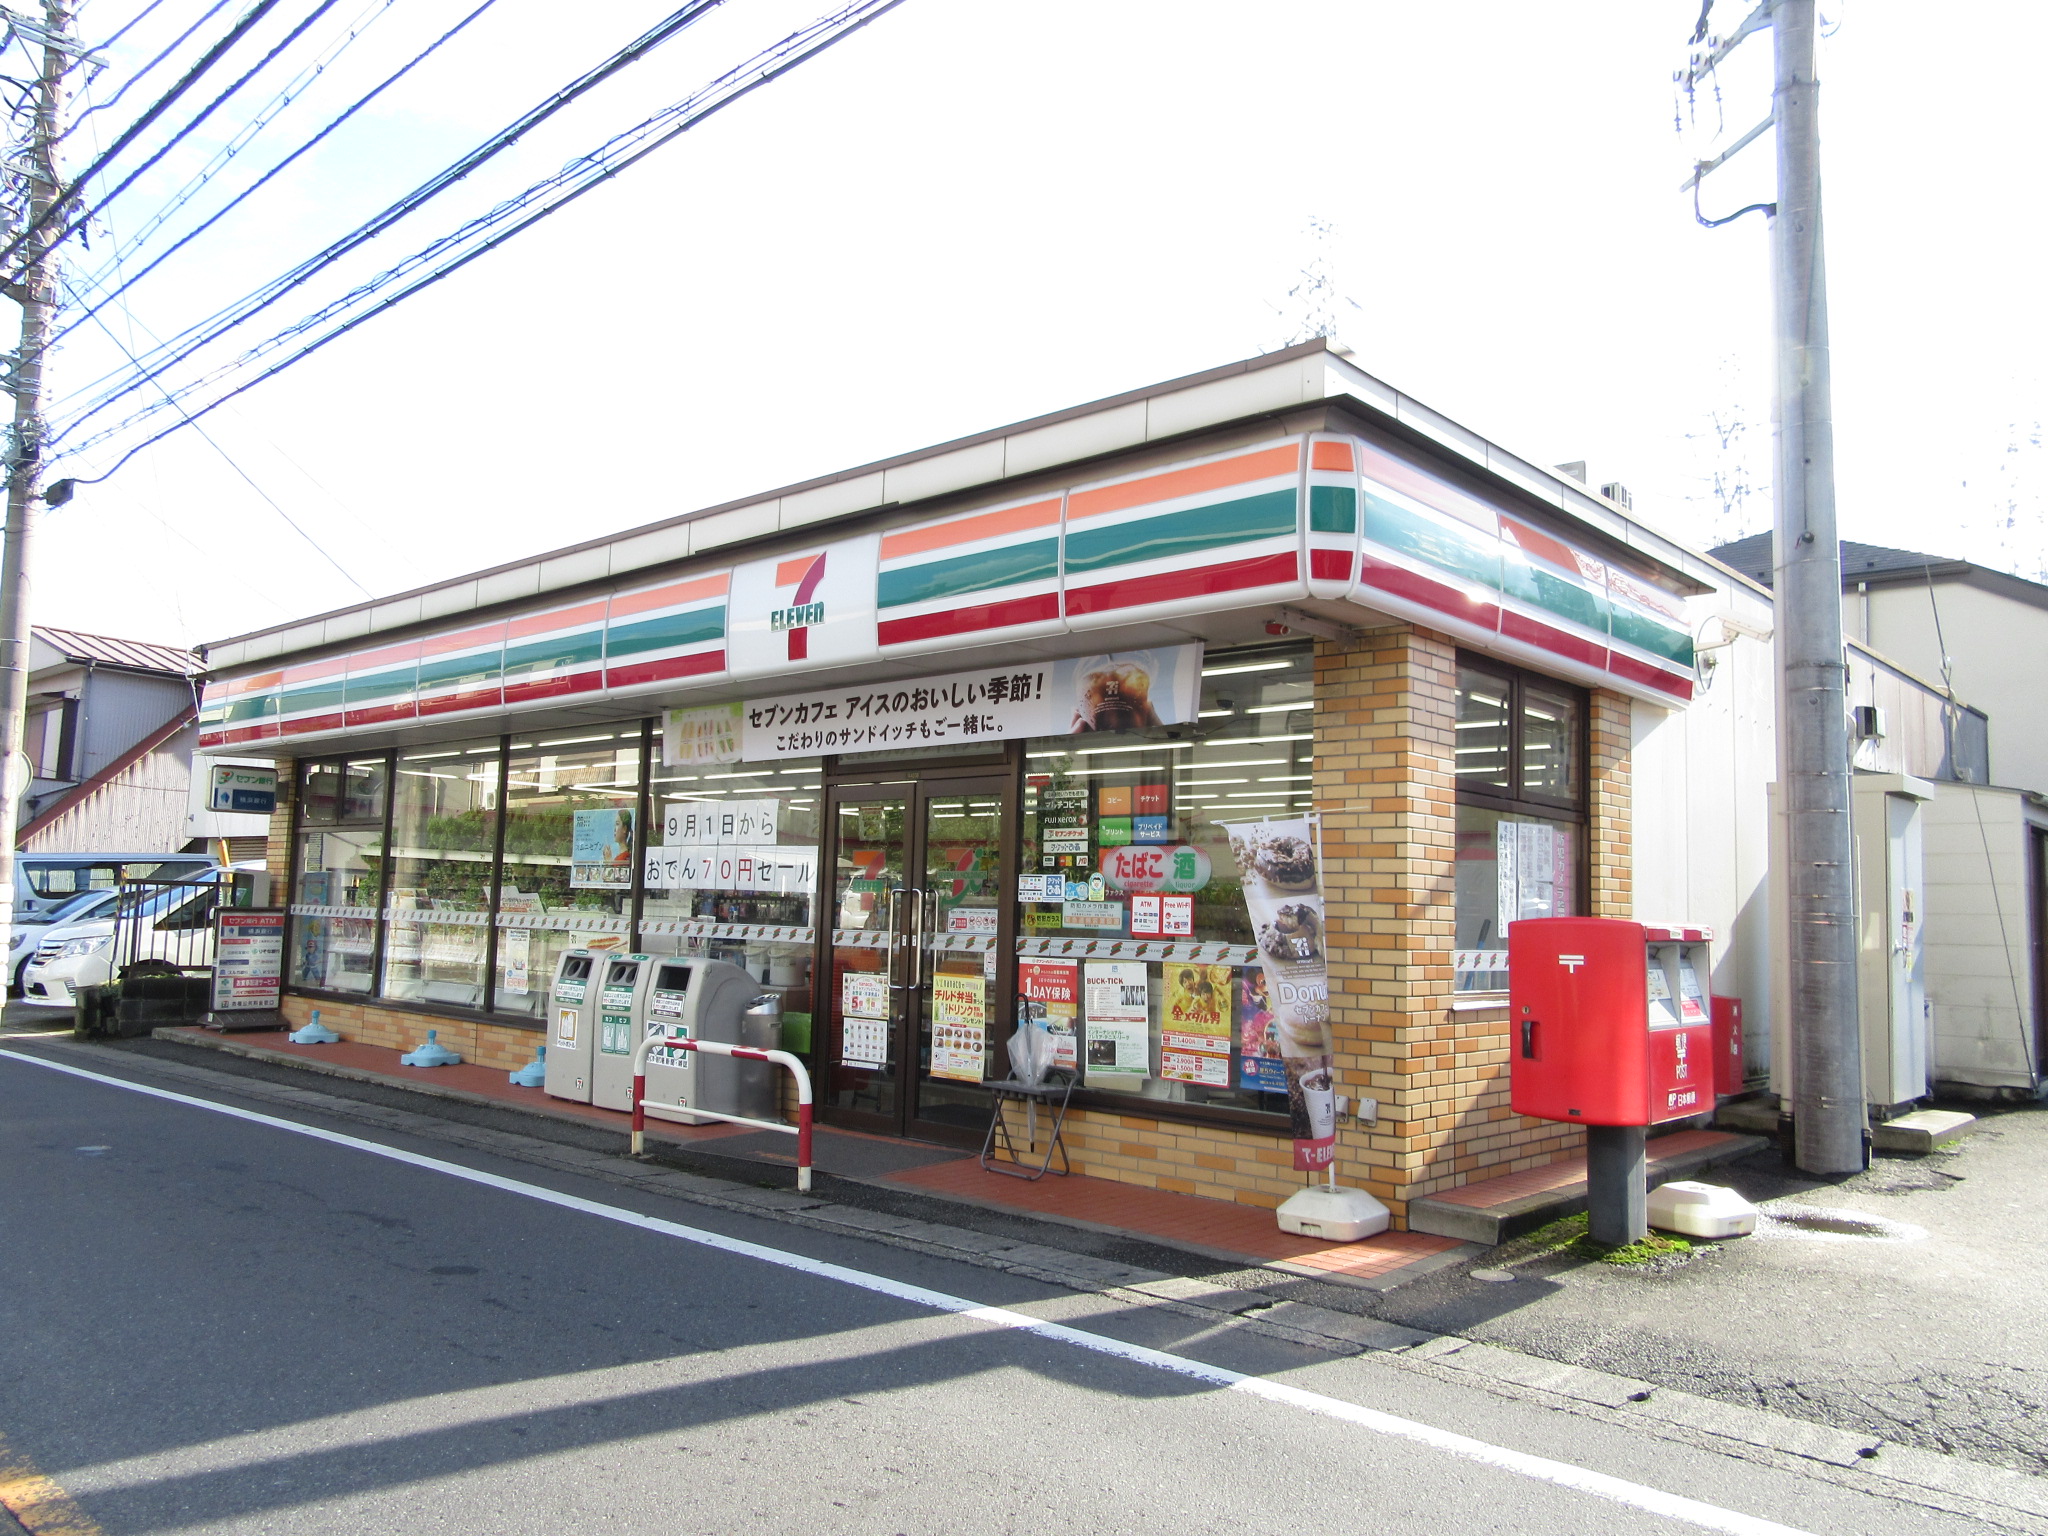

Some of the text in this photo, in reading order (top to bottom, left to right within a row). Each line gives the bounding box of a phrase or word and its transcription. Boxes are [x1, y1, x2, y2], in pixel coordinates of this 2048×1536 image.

[749, 672, 1044, 729] セブンカフェ アイスのおいしい季節!
[775, 714, 1004, 752] こだわりのサンドイッチもご一緒に。
[236, 774, 273, 785] セブン銀行
[668, 811, 774, 838] 9月1日から
[1105, 827, 1124, 835] プリント
[1138, 823, 1163, 831] プリペイド
[1055, 830, 1085, 838] セブンチケット
[646, 858, 815, 883] おでん70円セール
[1115, 852, 1196, 880] たばこ 酒
[1124, 880, 1196, 889] cigarette liquor
[1037, 915, 1060, 923] 防犯ガラス
[935, 989, 973, 1004] チルド弁当
[1025, 977, 1071, 1001] 1DAY保険
[948, 1003, 974, 1017] ドリンク
[1171, 1004, 1221, 1025] 金メダル男
[1675, 1033, 1688, 1051] 郵便
[1676, 1064, 1688, 1079] POST
[1677, 1091, 1696, 1107] 日本郵便
